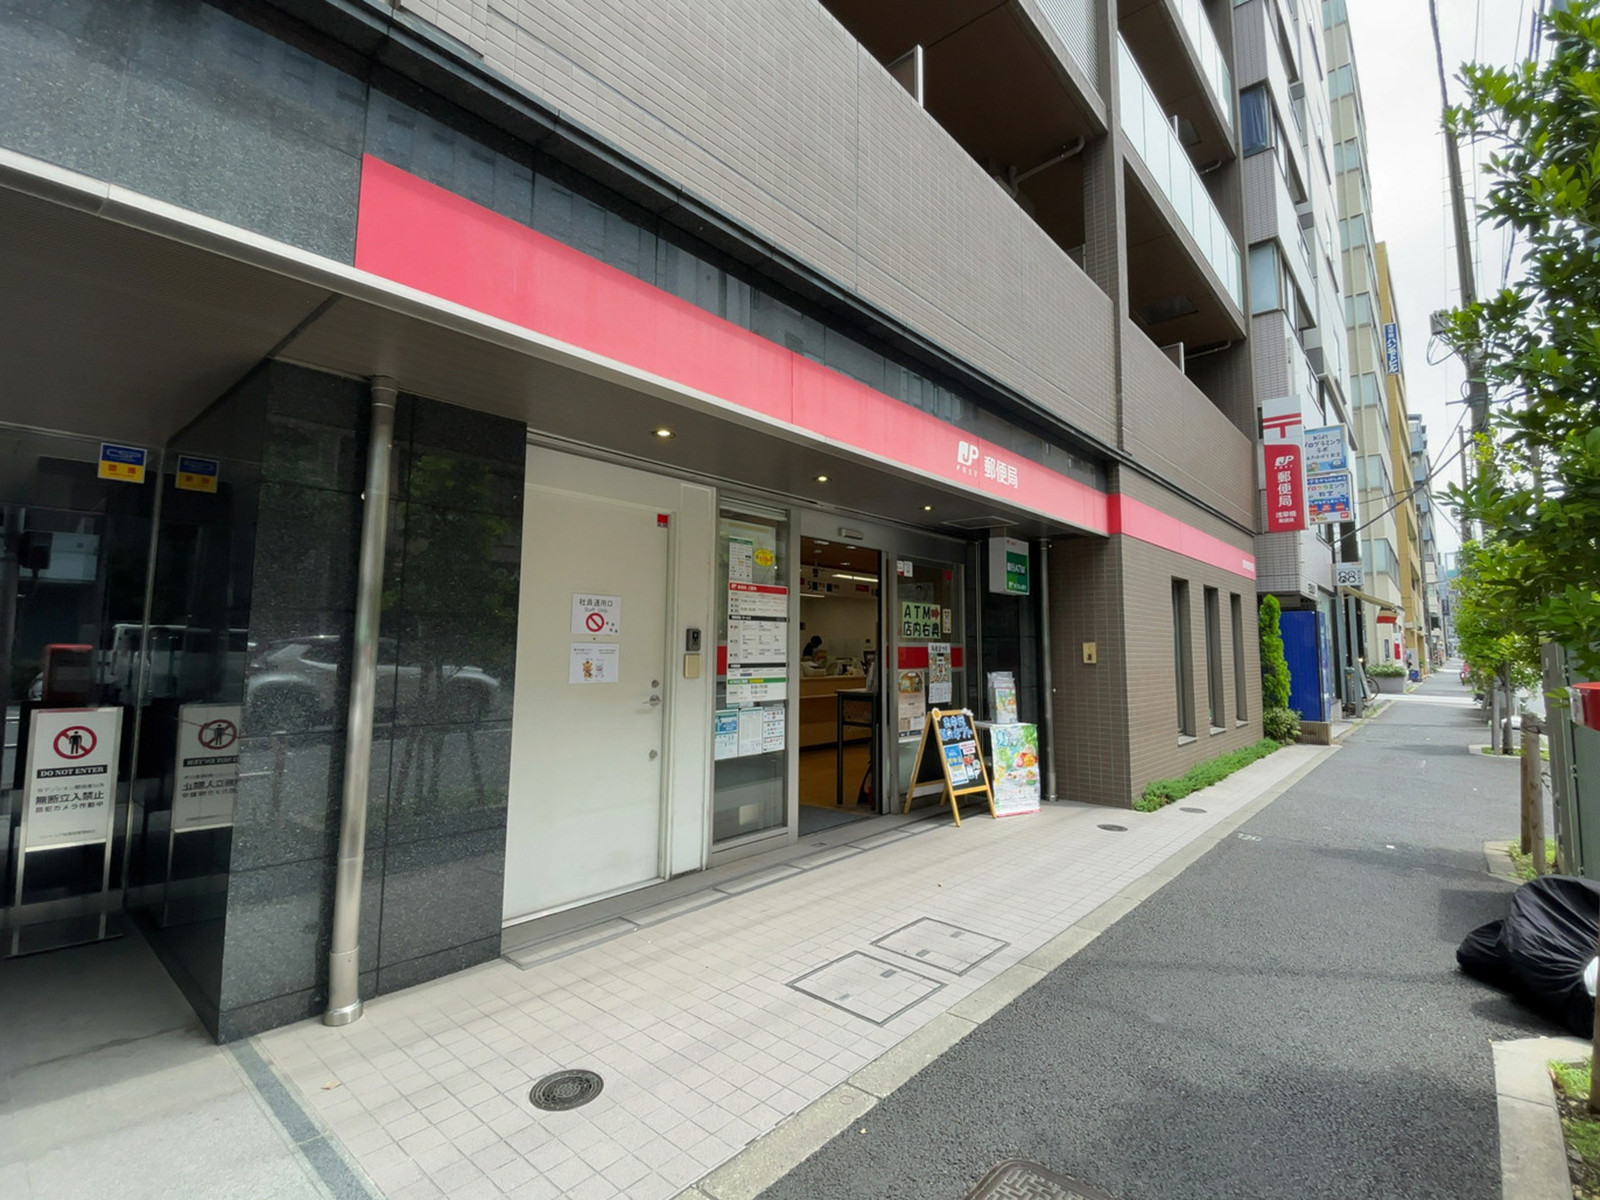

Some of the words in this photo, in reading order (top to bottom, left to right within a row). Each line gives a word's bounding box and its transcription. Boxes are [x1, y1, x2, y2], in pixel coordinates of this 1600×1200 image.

[1275, 455, 1294, 467] JP
[984, 455, 1018, 489] 郵便局
[1277, 470, 1293, 508] 郵便局
[579, 598, 614, 608] 社員通用口
[903, 604, 931, 620] ATM
[903, 620, 940, 638] 店内右奥
[54, 768, 74, 776] NOT
[75, 766, 104, 775] ENTER
[35, 790, 104, 805] 無断立入禁止
